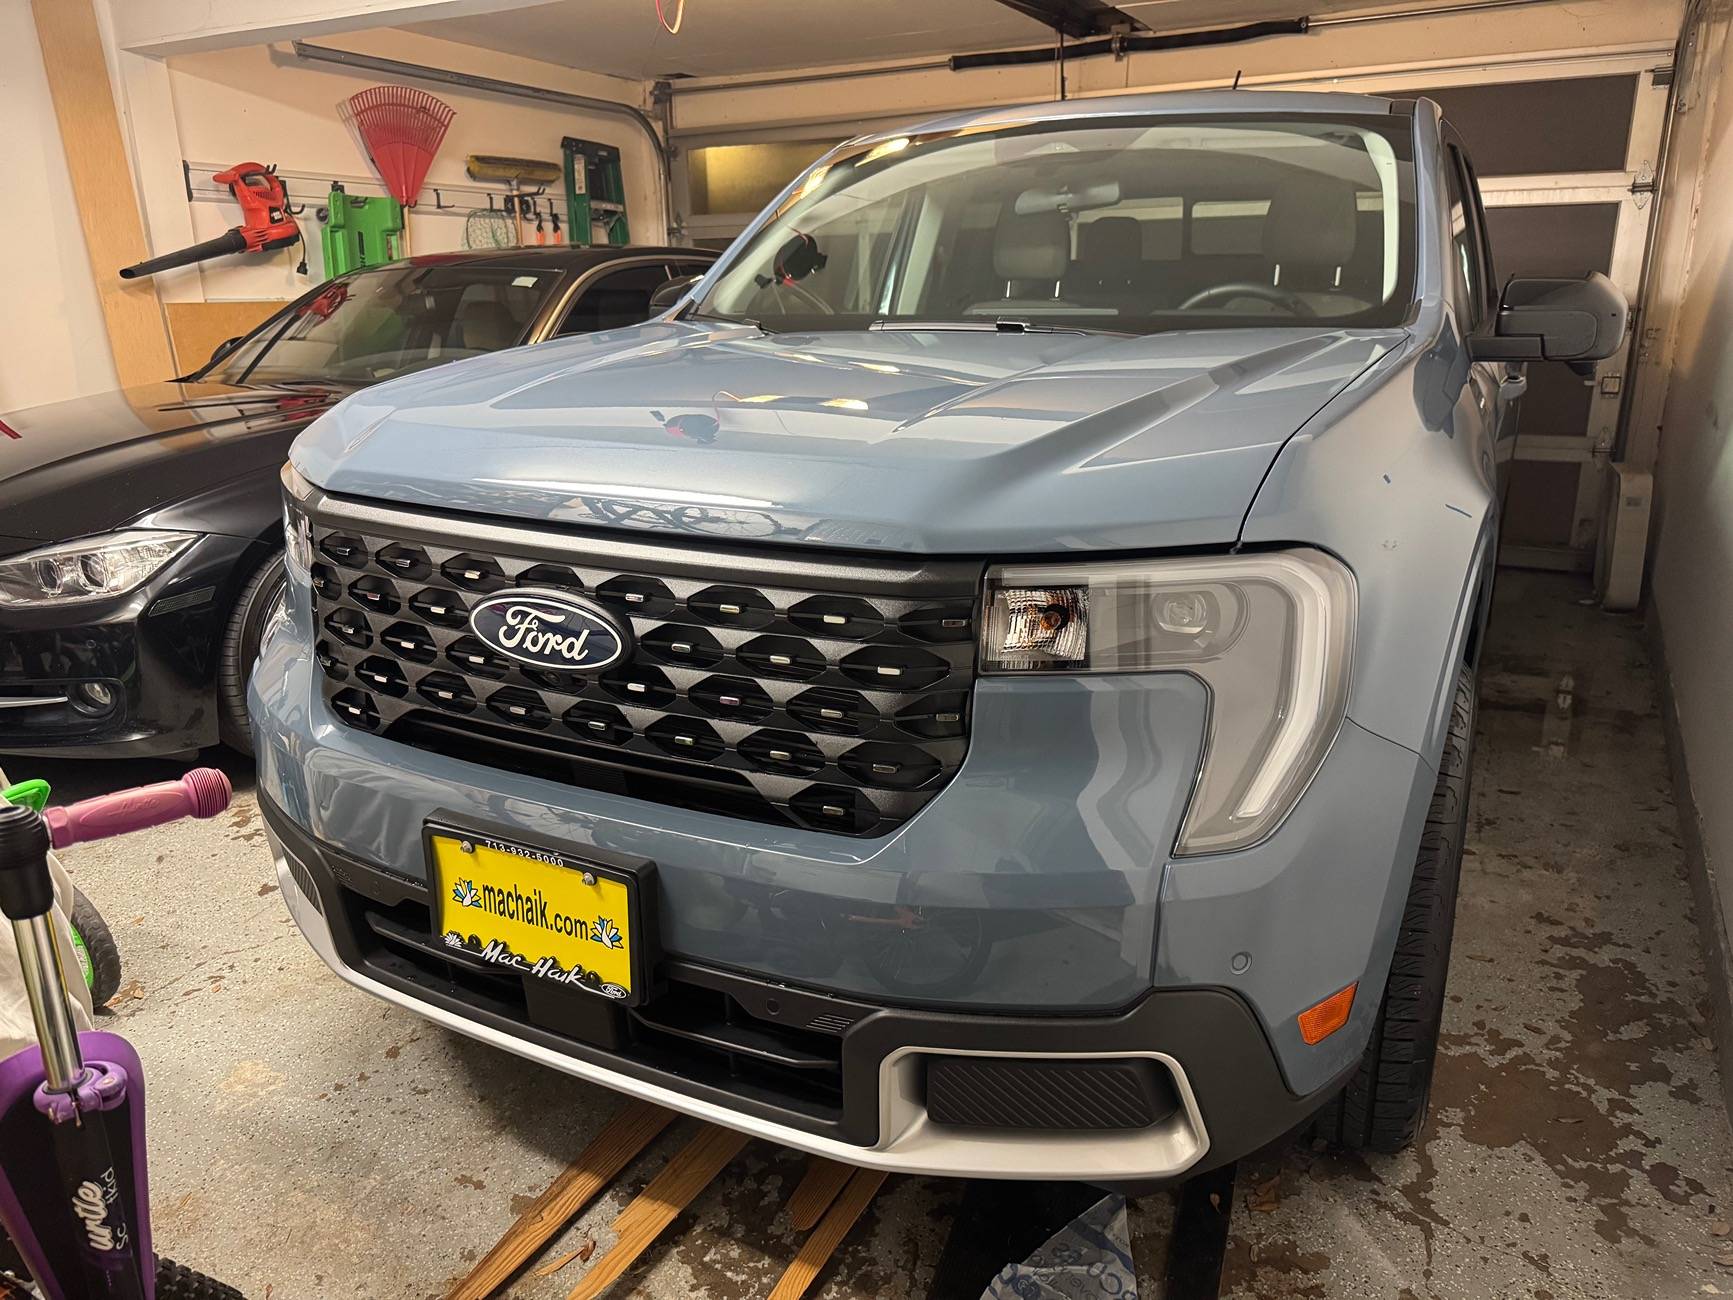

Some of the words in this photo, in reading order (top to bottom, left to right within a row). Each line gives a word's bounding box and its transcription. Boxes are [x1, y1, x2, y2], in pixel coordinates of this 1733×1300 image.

[498, 605, 590, 661] Ford
[482, 883, 589, 941] machaik.com
[480, 940, 531, 972] Mac
